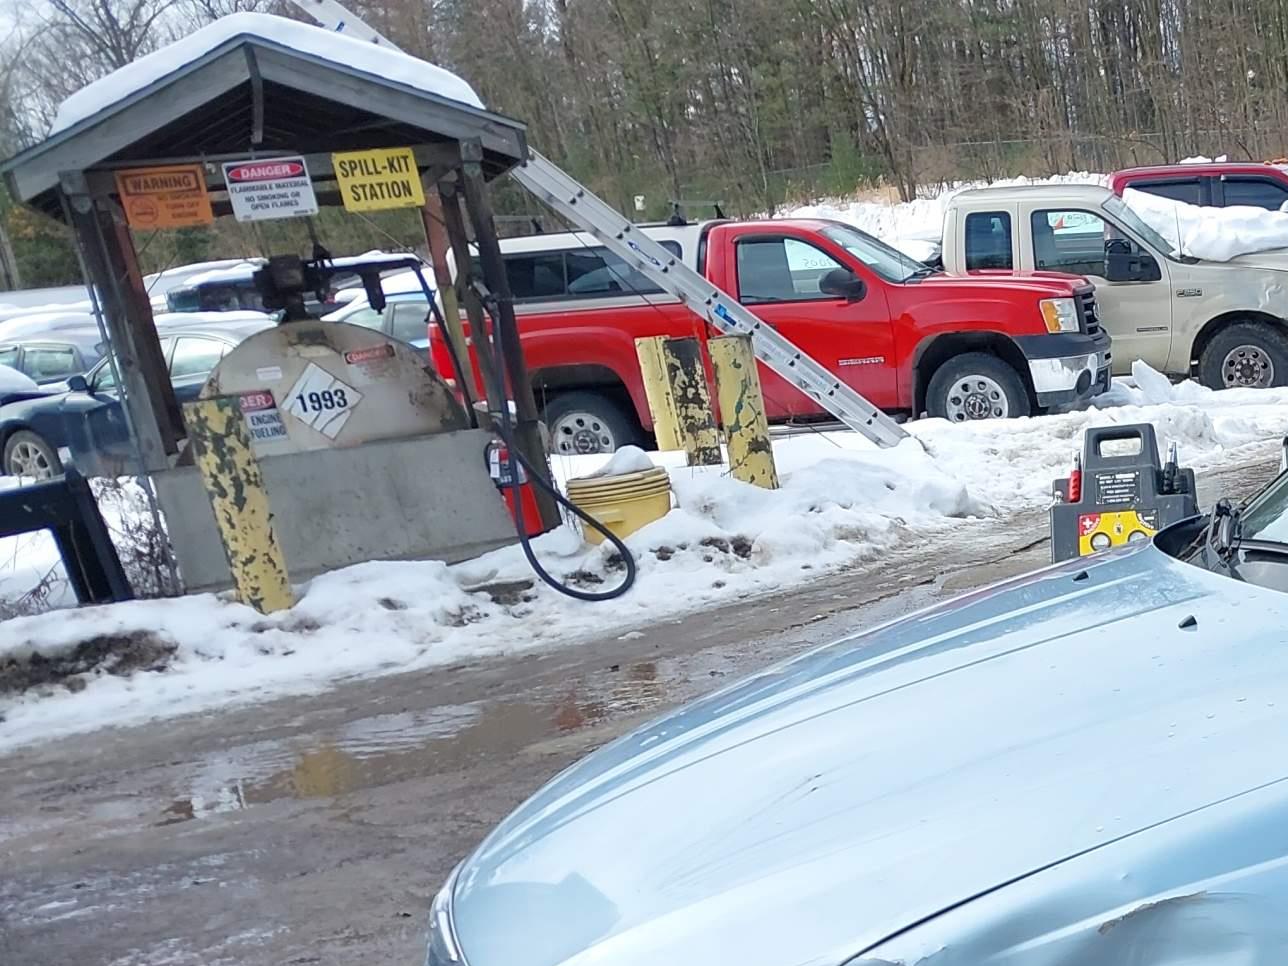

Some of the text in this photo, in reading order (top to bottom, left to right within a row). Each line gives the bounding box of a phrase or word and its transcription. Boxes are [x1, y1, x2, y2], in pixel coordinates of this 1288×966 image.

[240, 164, 291, 178] DANGER
[338, 155, 410, 178] SPILL-KIT
[130, 175, 192, 190] WARNING
[350, 180, 412, 202] STATION
[296, 389, 348, 413] 1993
